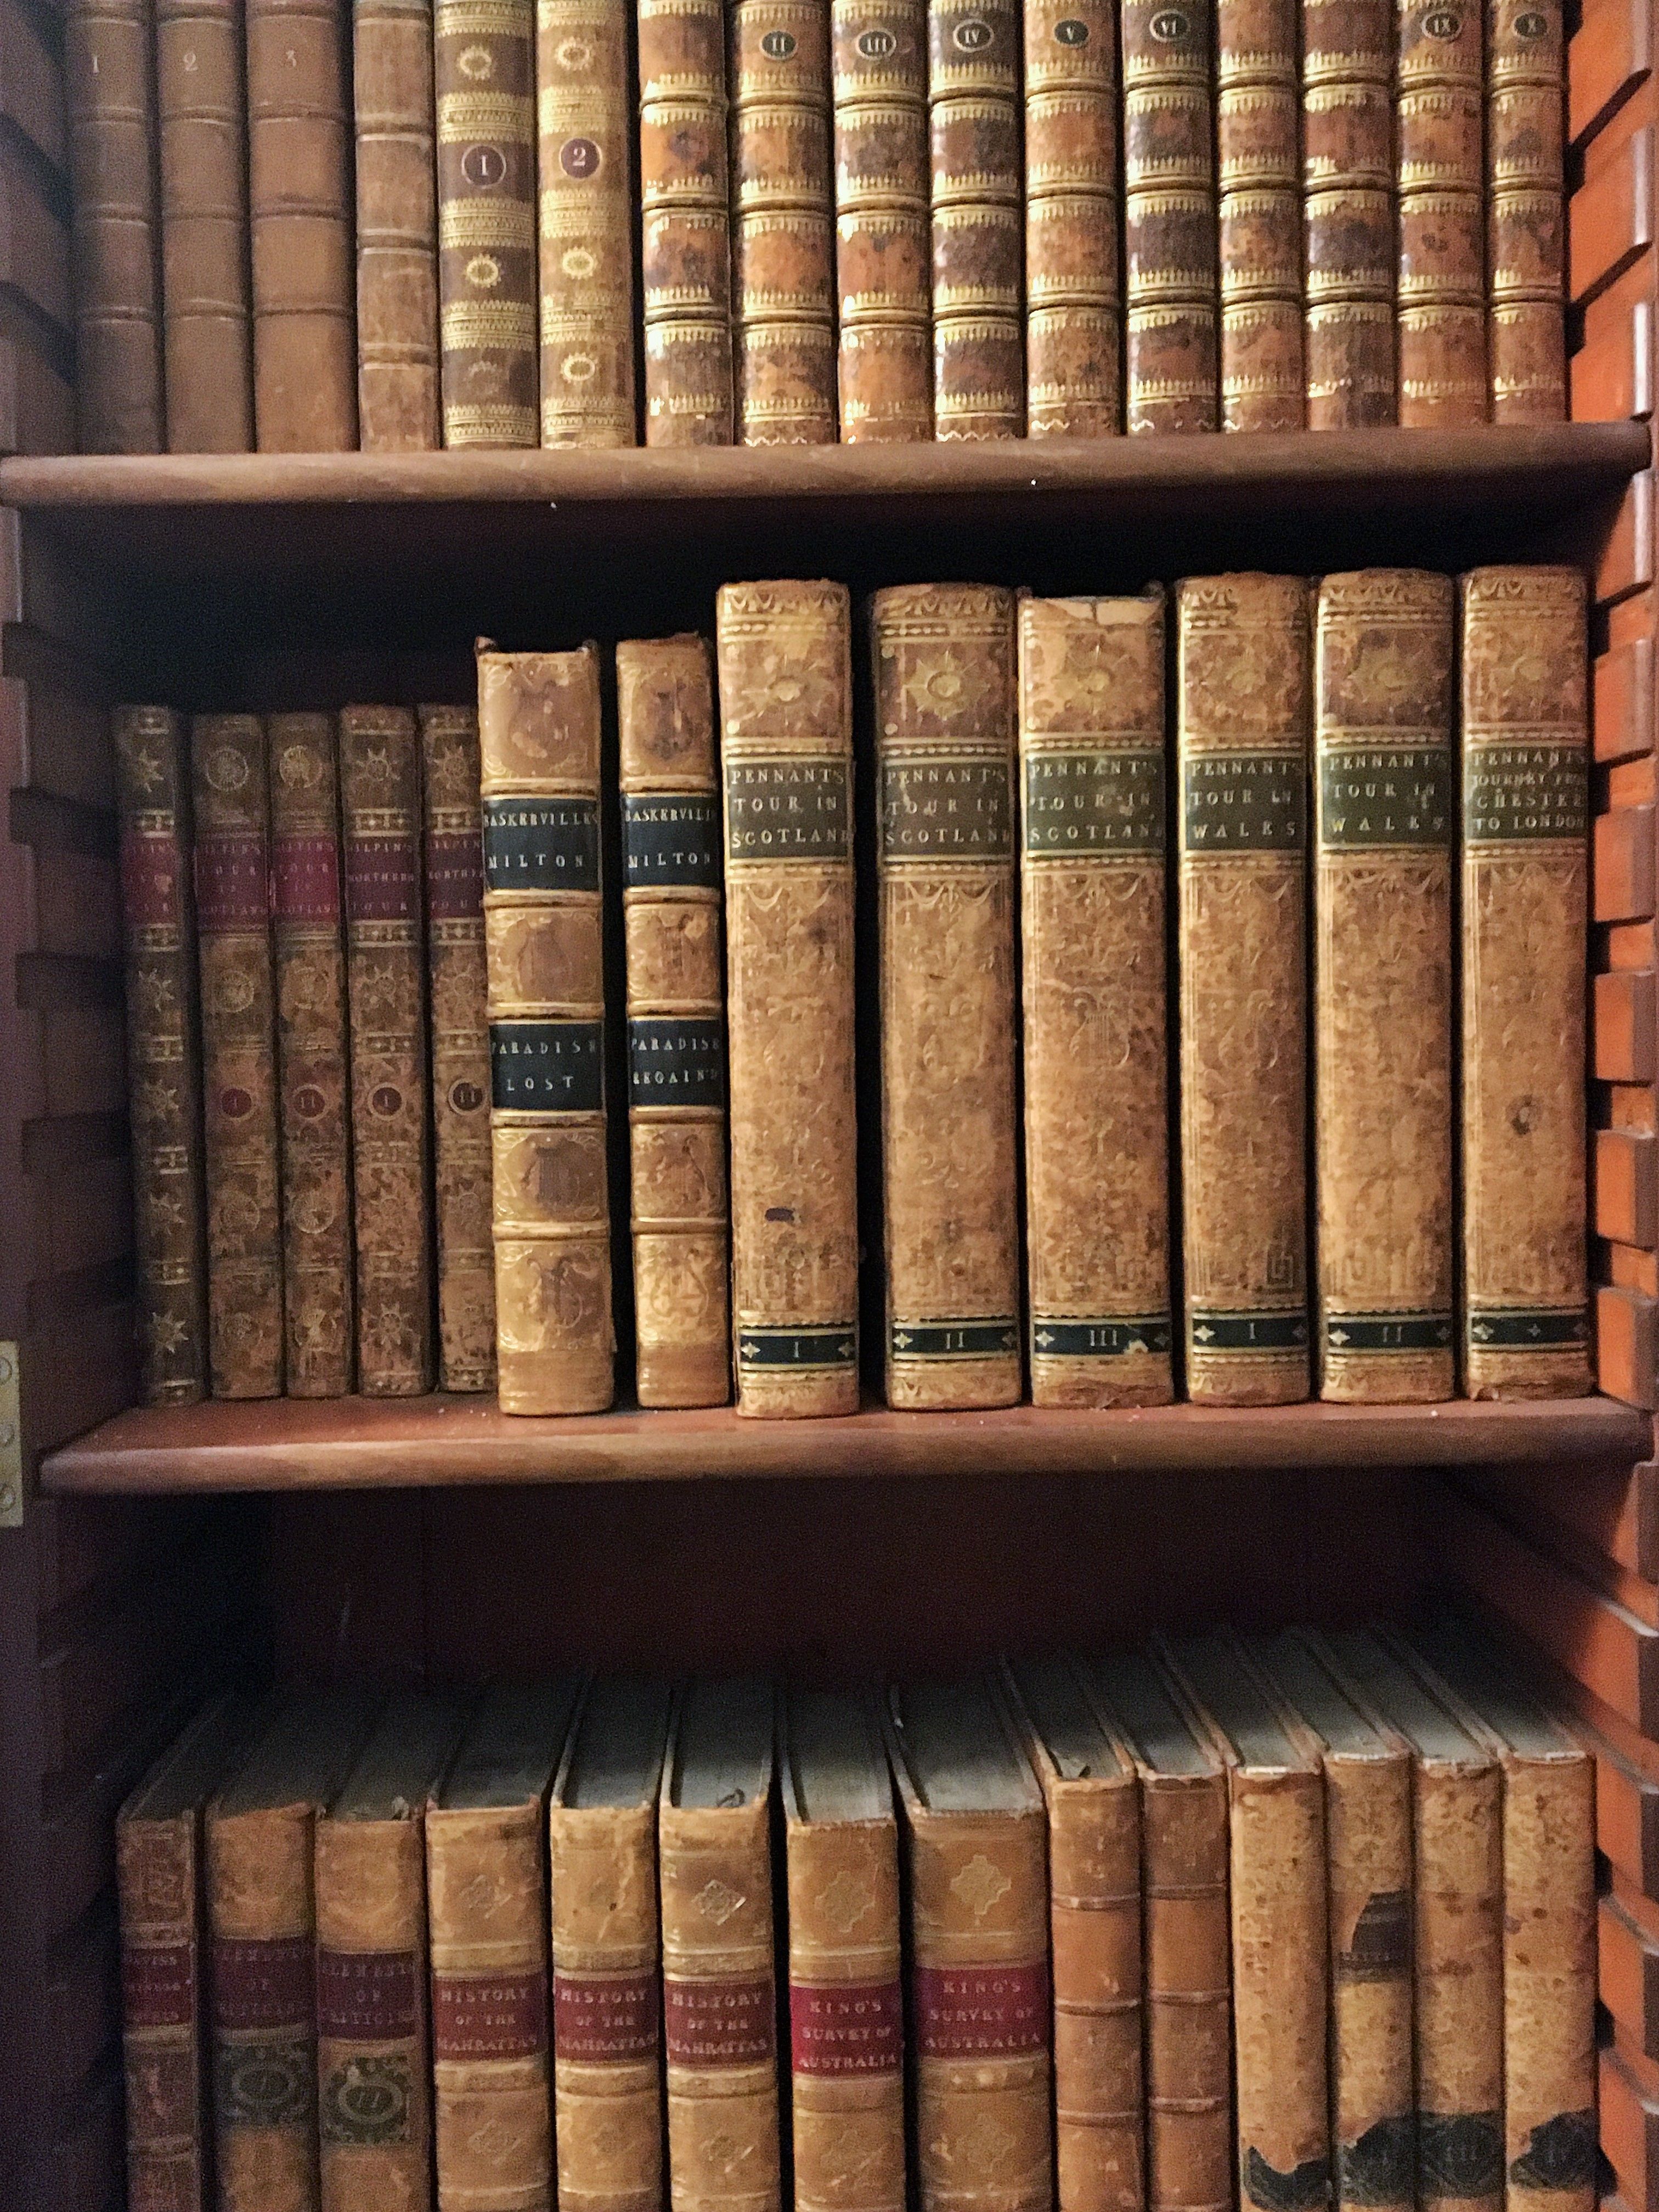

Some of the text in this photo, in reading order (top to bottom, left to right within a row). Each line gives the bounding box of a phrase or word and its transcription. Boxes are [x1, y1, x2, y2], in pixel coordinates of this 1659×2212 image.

[771, 36, 786, 53] II
[866, 37, 887, 53] III
[964, 29, 980, 44] IV
[182, 50, 199, 71] 2
[285, 50, 296, 67] 3
[573, 146, 586, 167] 2
[731, 768, 844, 785] PENNANT'S
[887, 767, 1005, 786] PENNANT'S
[1190, 789, 1291, 806] TOUR IN
[1330, 782, 1435, 799] TOUR IN
[733, 795, 837, 813] TOUR IN
[888, 798, 998, 816] TOUR IN
[1036, 793, 1150, 811] TOUR IN
[1192, 820, 1296, 839] WALES
[1331, 815, 1445, 833] WALES
[1472, 814, 1585, 831] TO LONDON
[488, 854, 583, 870] MILTON
[628, 851, 710, 868] MILTON
[631, 1037, 719, 1051] PARADISE
[506, 1075, 574, 1092] LOST
[1089, 1329, 1118, 1346] III
[943, 1979, 1021, 1994] KING'S
[441, 1988, 528, 2004] HISTORY
[561, 1988, 647, 2004] HISTORY
[672, 1991, 763, 2008] HISTORY
[809, 2000, 882, 2015] KING'S
[928, 2007, 1003, 2023] SURVEY
[601, 2015, 635, 2028] THE
[714, 2018, 749, 2031] THE
[801, 2026, 871, 2041] SURVEY
[924, 2033, 1040, 2050] AUSTRALIA
[437, 2034, 538, 2052] MAHRATTAS
[798, 2054, 896, 2070] AUSTRALIA
